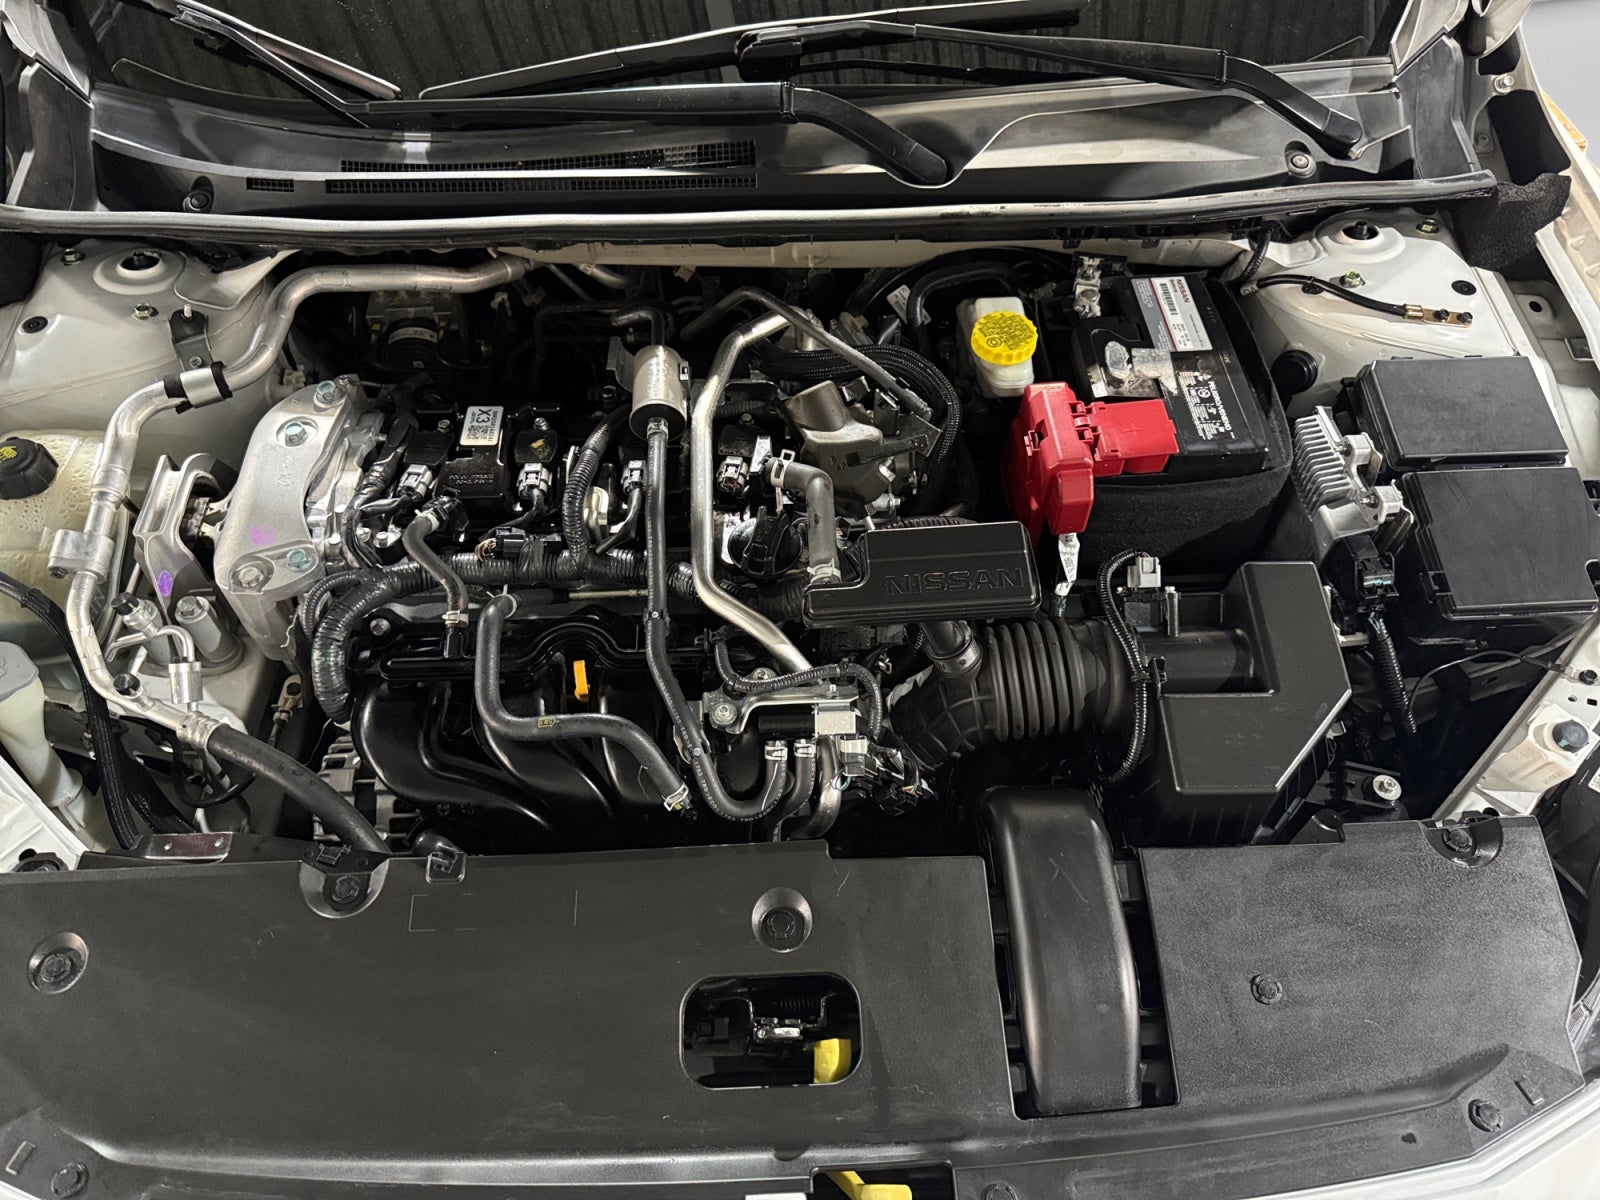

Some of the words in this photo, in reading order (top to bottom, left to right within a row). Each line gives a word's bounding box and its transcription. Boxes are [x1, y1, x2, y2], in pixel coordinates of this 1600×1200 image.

[1175, 278, 1190, 303] NISSAN
[476, 408, 493, 424] X3
[885, 567, 1025, 596] NISSAN
